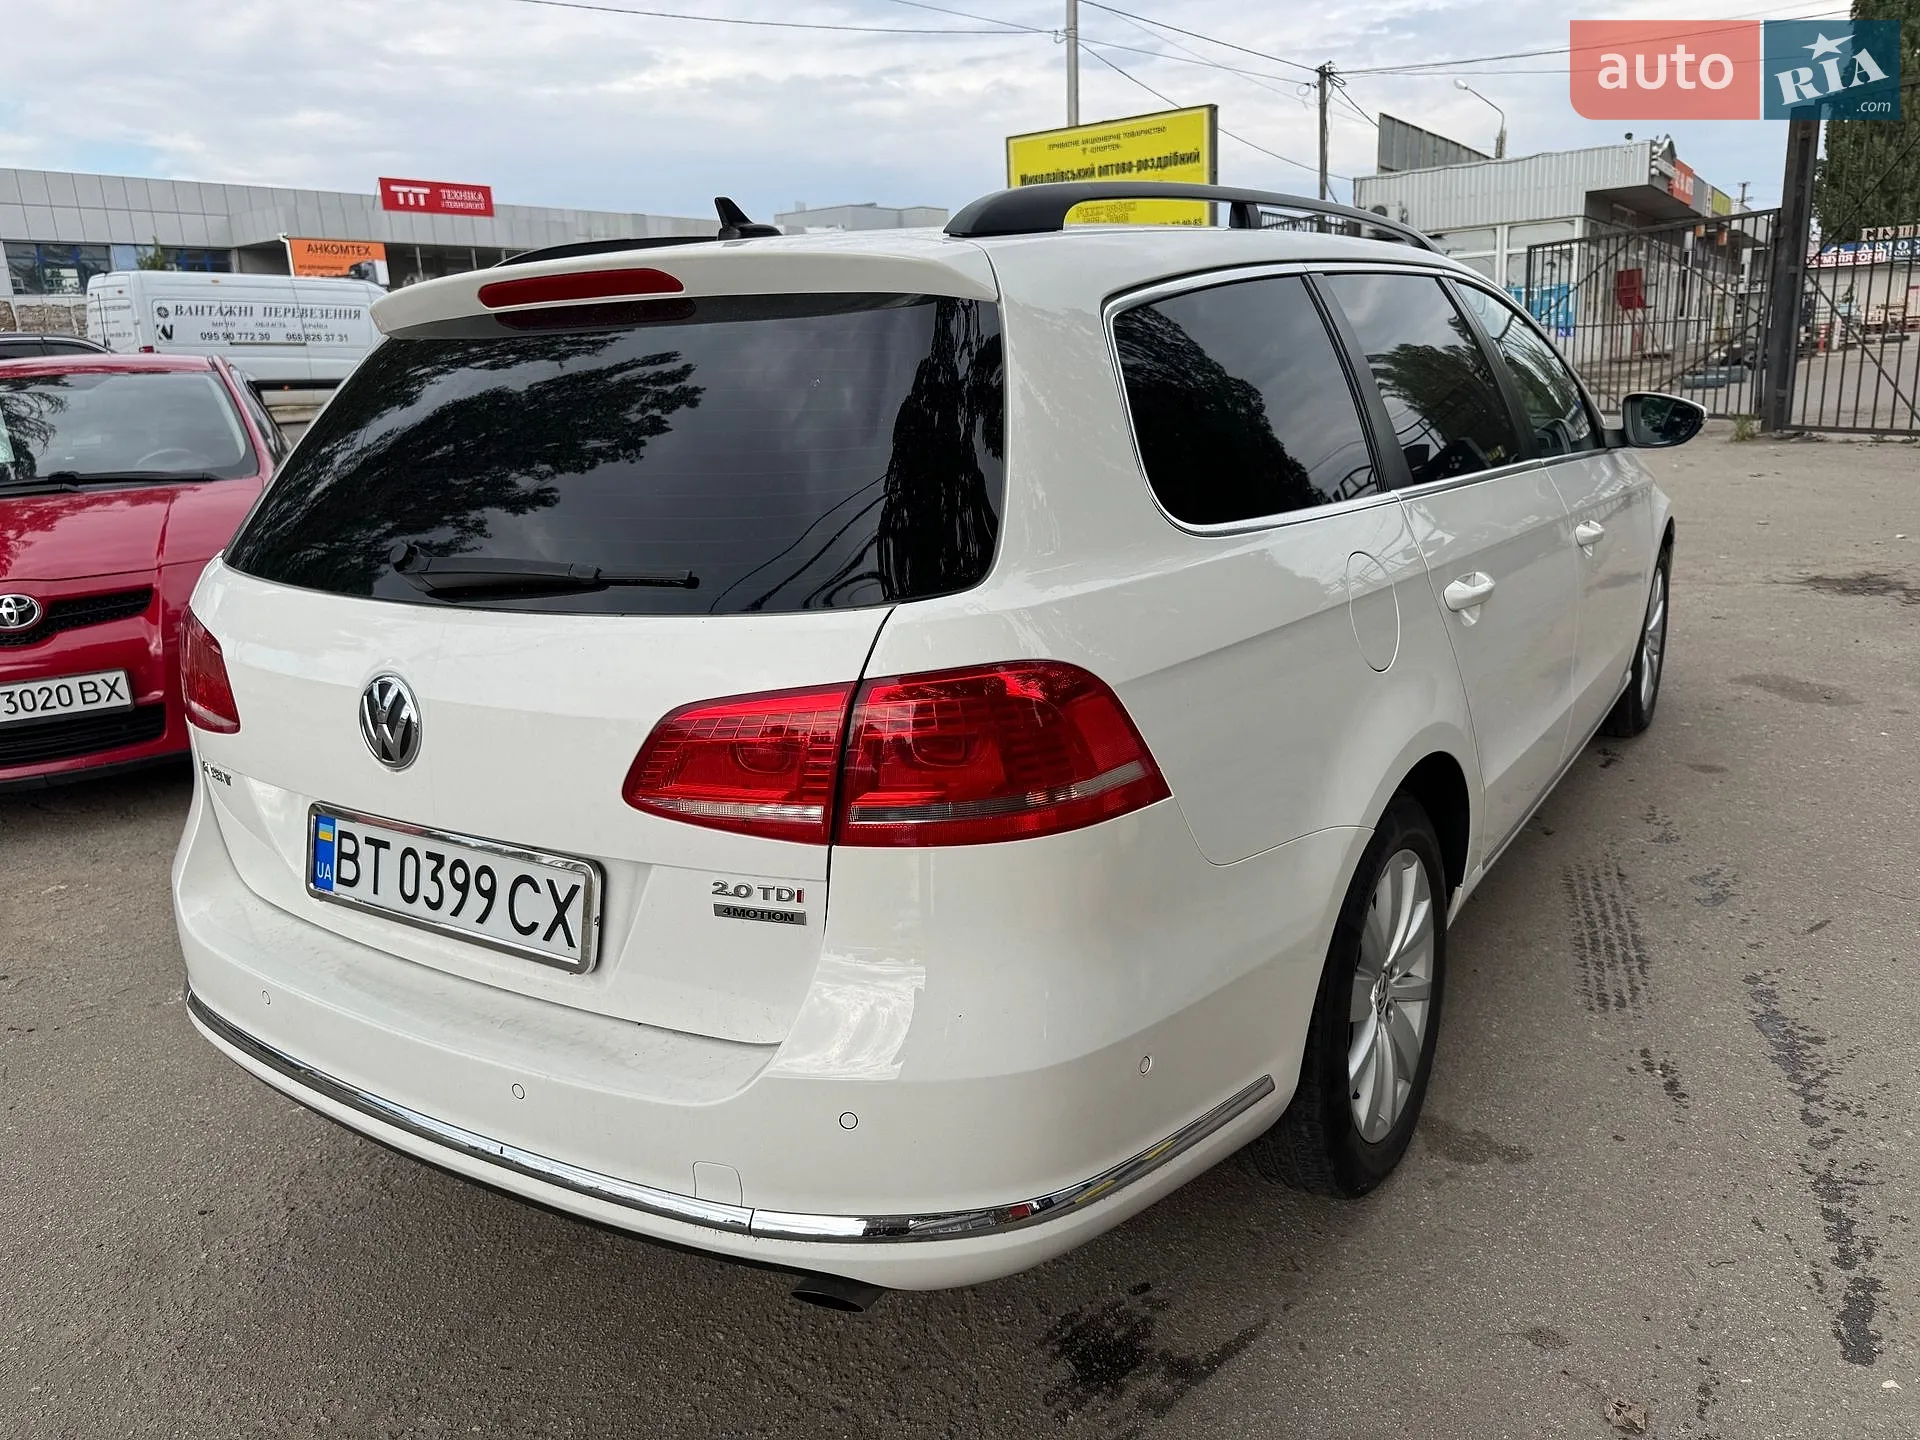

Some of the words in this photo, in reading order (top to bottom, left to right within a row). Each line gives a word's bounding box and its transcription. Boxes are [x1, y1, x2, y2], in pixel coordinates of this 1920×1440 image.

[306, 243, 372, 256] АНКОМТЕХ
[174, 304, 254, 317] ВАНТАЖНІ
[263, 306, 361, 321] ПЕРЕВЕЗЕННЯ
[200, 332, 220, 341] 095
[236, 332, 256, 341] 772
[0, 683, 74, 716] 3020
[78, 676, 125, 706] BX
[316, 860, 333, 881] UA
[336, 829, 391, 897] BT
[398, 845, 498, 926] 0399
[508, 873, 581, 949] CX
[711, 879, 754, 899] 2.0
[757, 884, 805, 904] TDI
[722, 906, 796, 922] 4MOTION
